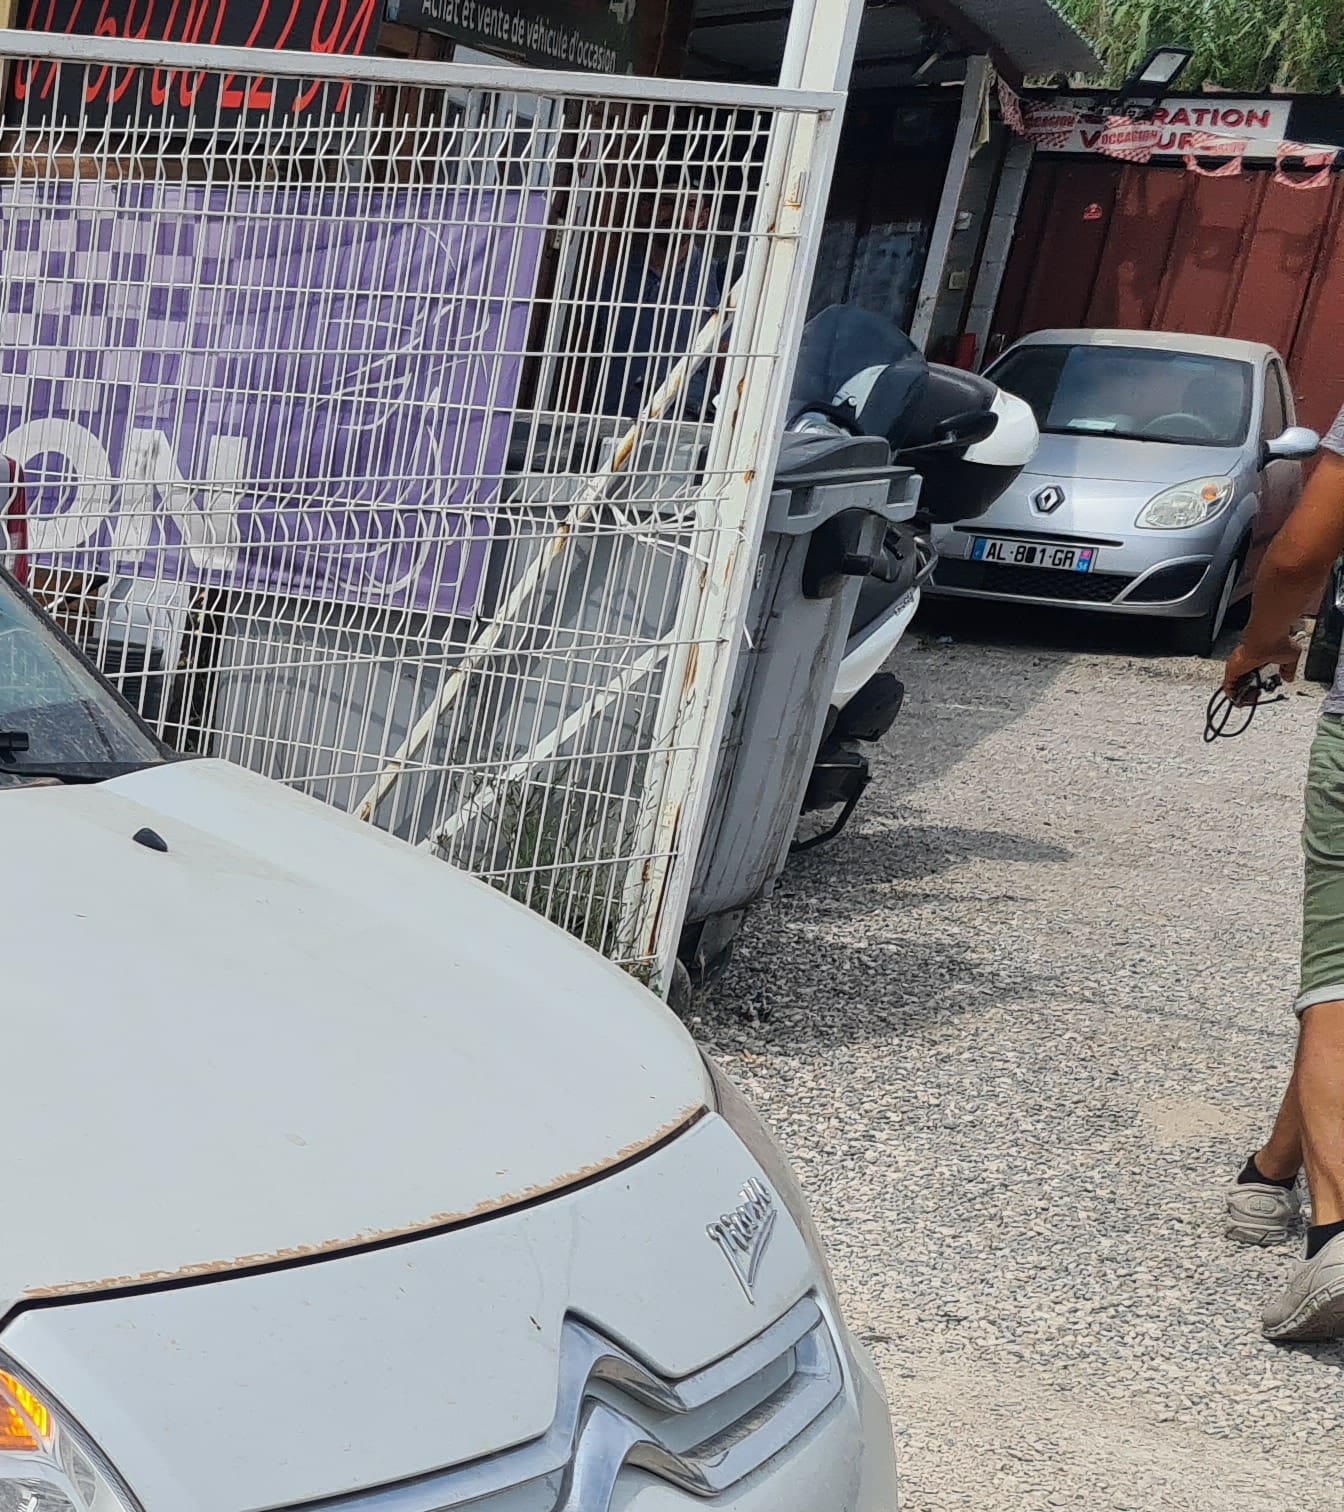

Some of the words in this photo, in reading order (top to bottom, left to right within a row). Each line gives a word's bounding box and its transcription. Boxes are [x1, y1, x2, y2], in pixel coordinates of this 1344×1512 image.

[422, 0, 459, 24] Achat
[462, 0, 475, 29] et
[478, 4, 509, 40] vente
[511, 9, 525, 46] de
[526, 15, 568, 60] véhicule
[568, 30, 616, 73] d'occasion
